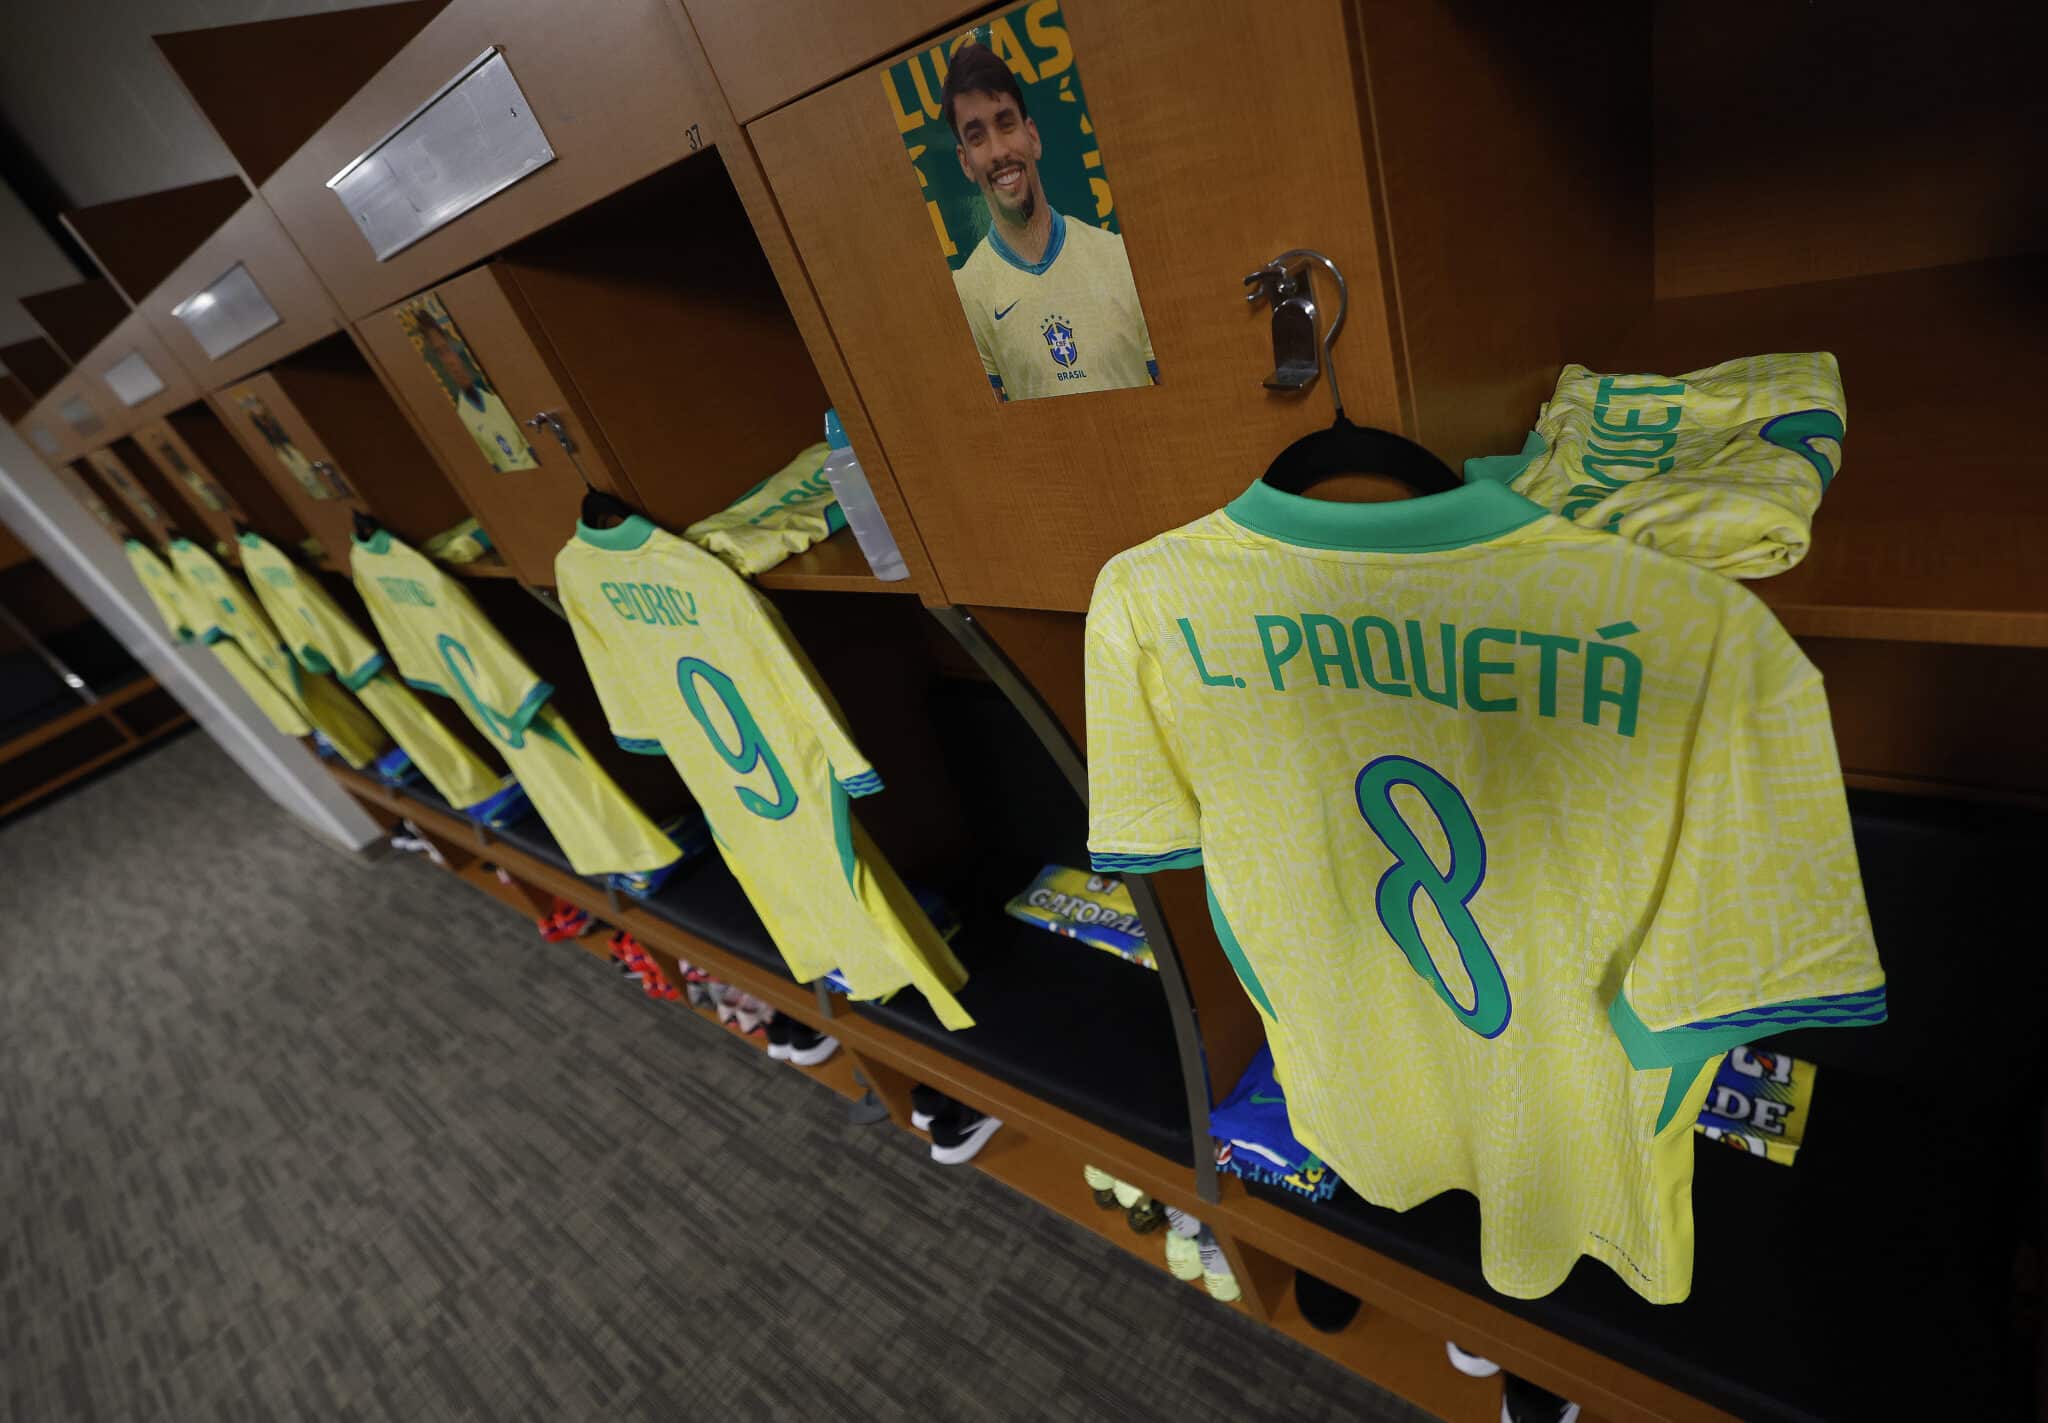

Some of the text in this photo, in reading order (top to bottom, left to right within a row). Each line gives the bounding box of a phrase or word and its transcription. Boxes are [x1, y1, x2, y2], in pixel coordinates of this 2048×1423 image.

[880, 0, 1073, 134] LUAS
[684, 122, 703, 151] 37
[1056, 369, 1088, 382] BRASIL
[1176, 613, 1643, 738] L. PAQUETÁ
[676, 656, 799, 820] 9
[1029, 888, 1148, 942] GATORA
[1355, 755, 1512, 1039] 8
[1702, 1085, 1793, 1135] DE
